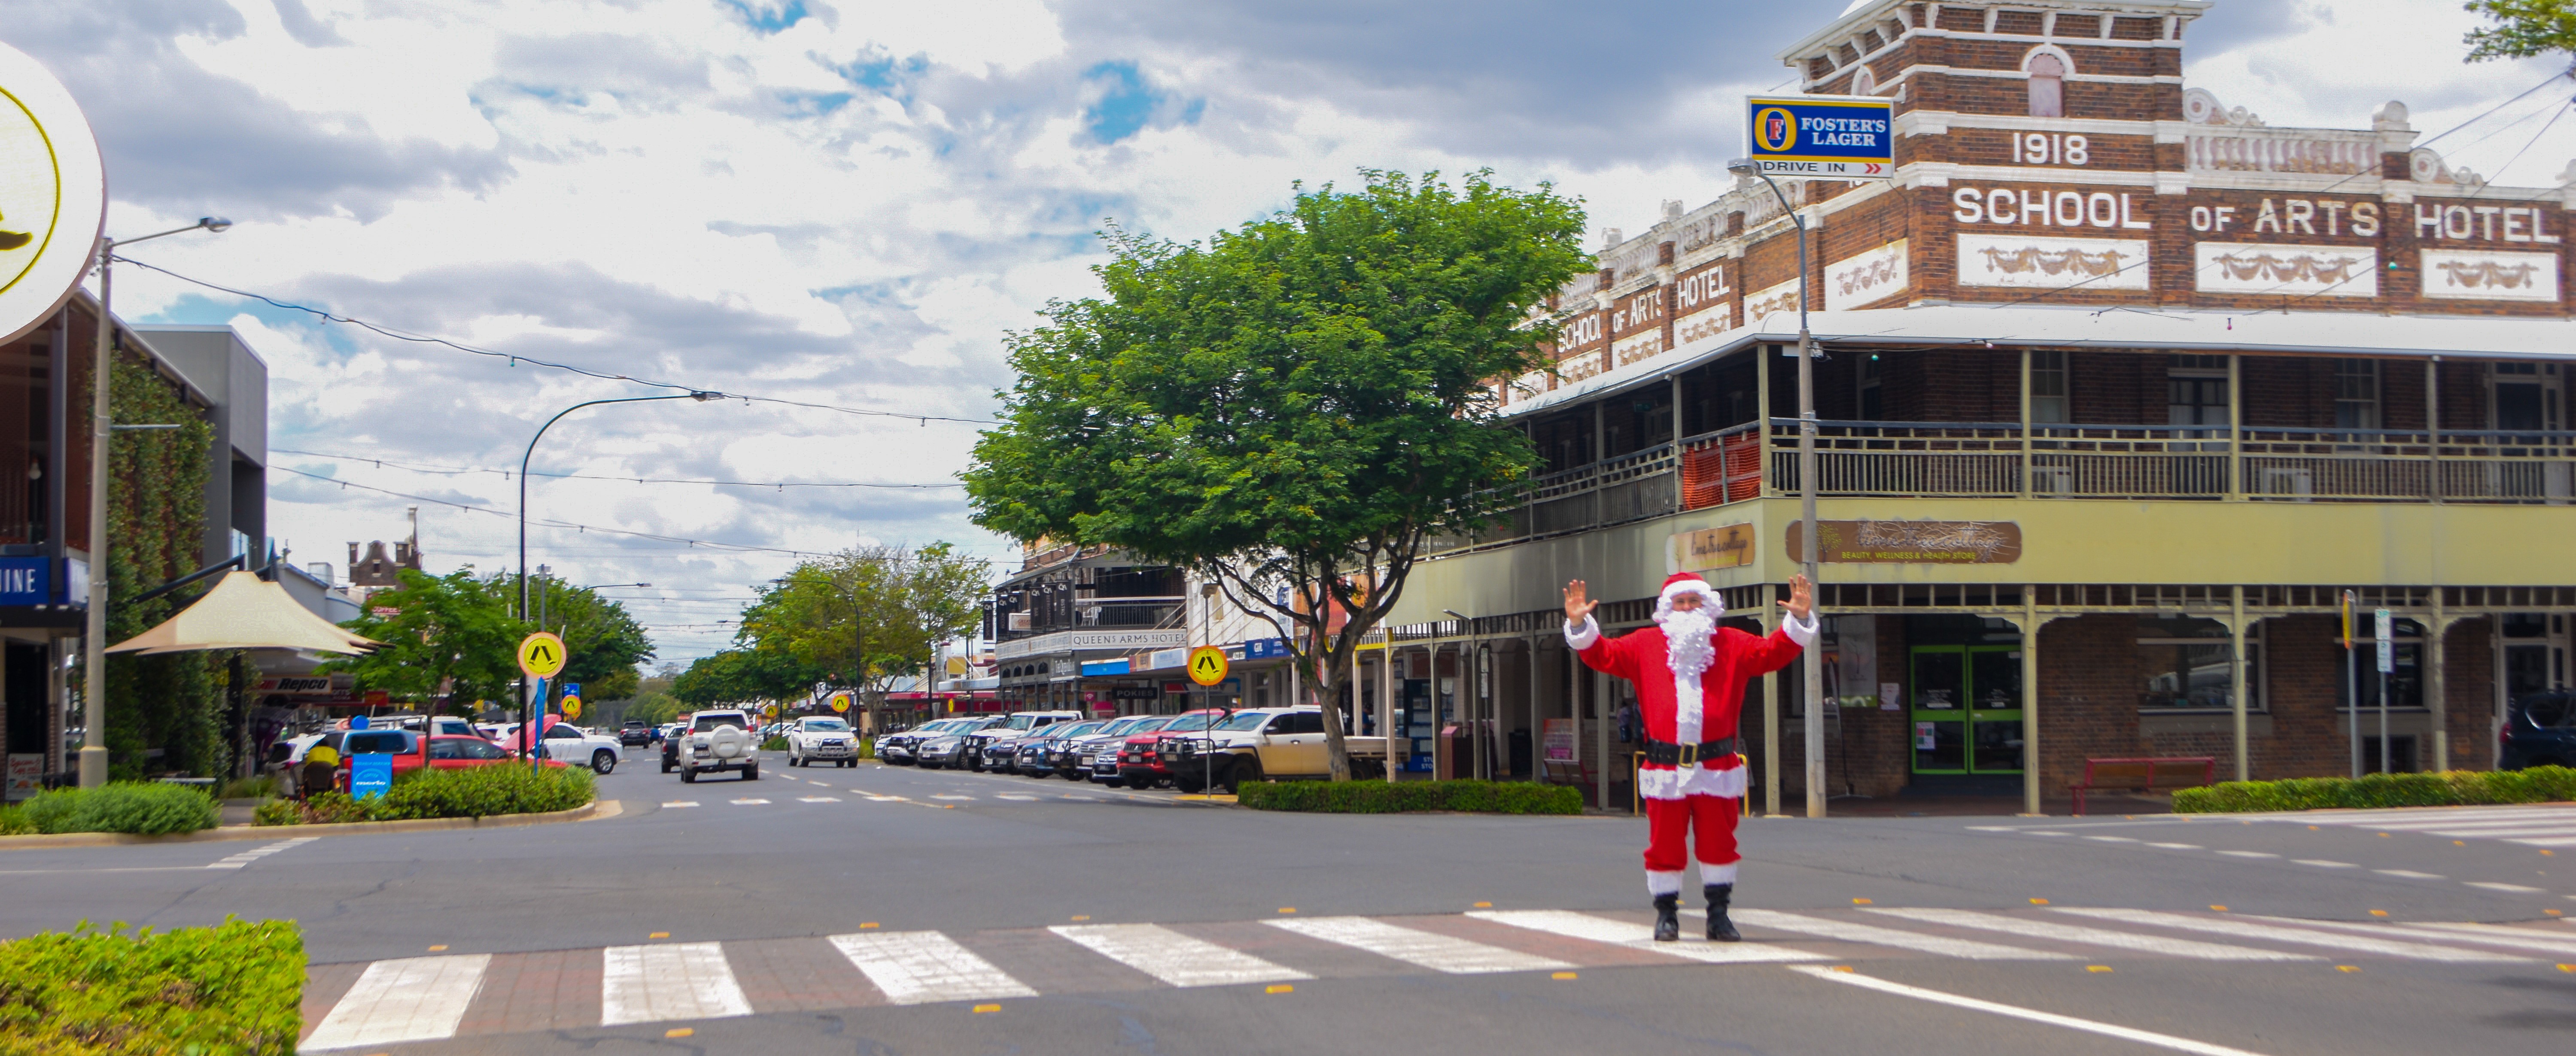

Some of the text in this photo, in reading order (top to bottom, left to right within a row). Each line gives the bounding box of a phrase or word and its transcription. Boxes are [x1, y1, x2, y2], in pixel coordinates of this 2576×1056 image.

[1801, 117, 1886, 133] FOSTER'S
[1812, 132, 1876, 146] LAGER
[2013, 133, 2088, 165] 1918
[1764, 161, 1845, 172] DRIVE IN
[1953, 188, 2560, 243] SCHOOL OF ARTS HOTEL
[1612, 310, 1625, 333] OF
[1677, 265, 1730, 310] HOTEL
[0, 569, 36, 594] INE
[1074, 635, 1116, 646] QUEENS
[1120, 635, 1148, 643] ARMS
[1152, 634, 1186, 643] HOTEL
[277, 678, 328, 692] Repco
